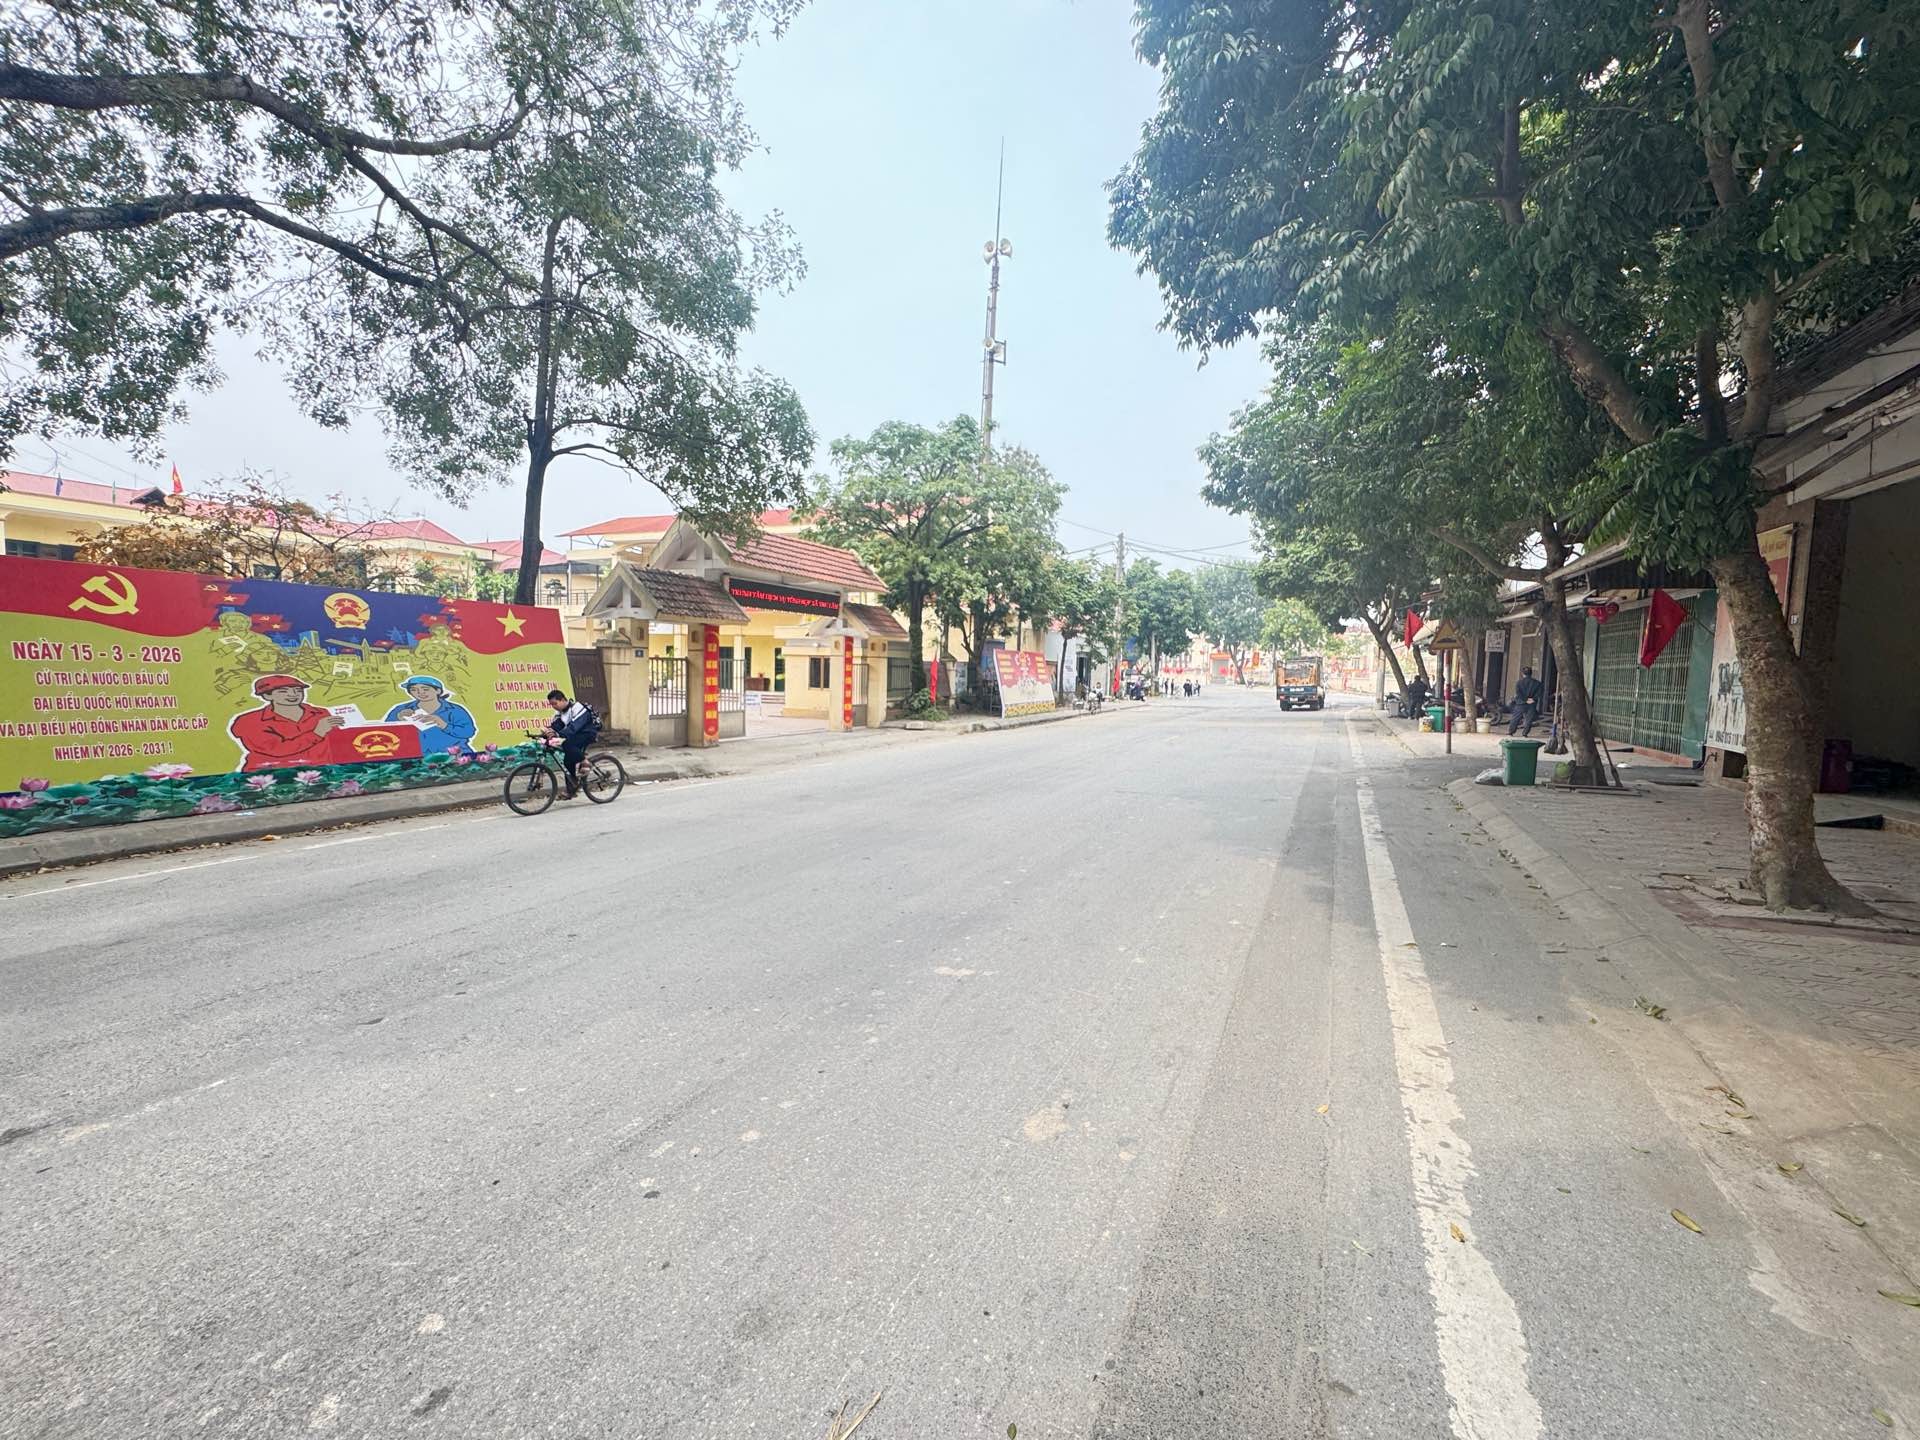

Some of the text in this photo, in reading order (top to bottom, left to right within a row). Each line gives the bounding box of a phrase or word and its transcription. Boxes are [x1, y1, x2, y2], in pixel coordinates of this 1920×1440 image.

[12, 638, 63, 660] NGÀY
[70, 644, 93, 661] 15
[112, 645, 123, 662] 3
[141, 646, 182, 662] 2026
[54, 672, 72, 685] TRI
[122, 672, 132, 686] ĐI
[34, 696, 53, 712] ĐẠI
[56, 691, 80, 710] BIỂU
[84, 692, 112, 711] QUỐC
[115, 694, 132, 712] HỘI
[162, 696, 177, 708] XVI
[0, 713, 208, 740] VÀ ĐẠI BIỂU HỘI ĐỒNG NHÂN DÂN CÁC CẤP
[54, 743, 90, 762] NHIỆM
[93, 742, 105, 758] KỲ
[108, 744, 133, 758] 2026
[142, 742, 166, 756] 2031
